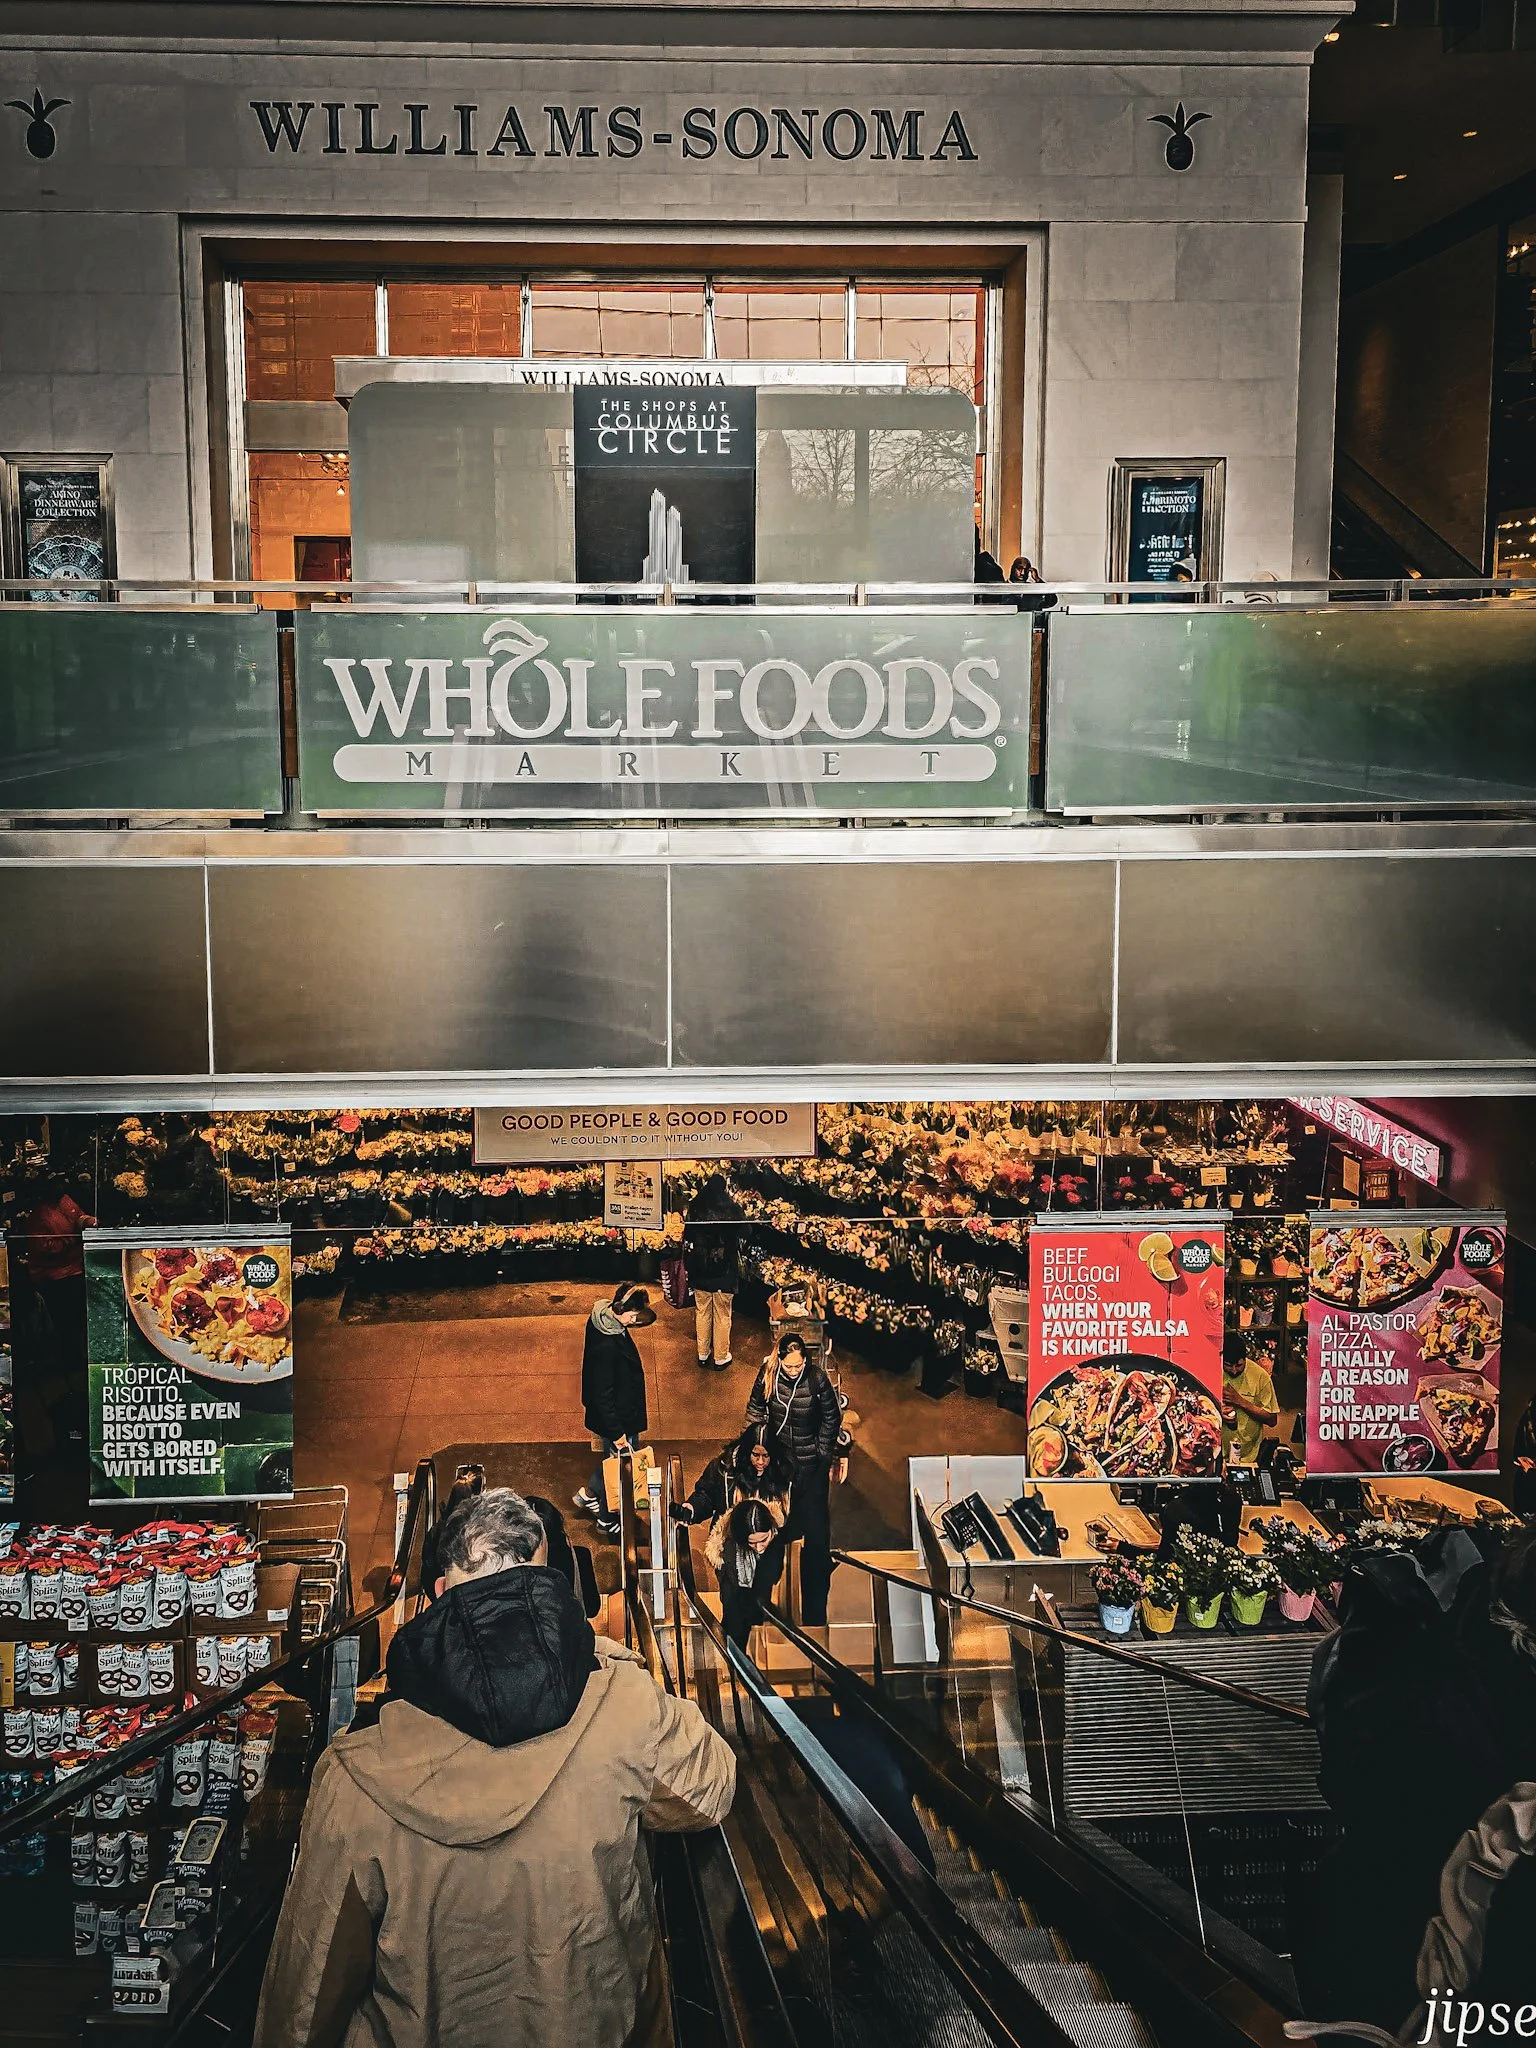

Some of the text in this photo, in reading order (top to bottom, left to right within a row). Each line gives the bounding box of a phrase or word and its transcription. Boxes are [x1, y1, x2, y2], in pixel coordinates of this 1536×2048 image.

[250, 100, 979, 161] WILLIAMS-SONOMA
[520, 371, 726, 386] WILLIAMS-SONOMA
[601, 400, 726, 412] THE SHOPS AT
[597, 413, 731, 430] COLUMBUS
[597, 430, 731, 454] CIRCLE
[34, 499, 98, 508] DINNERWARE
[35, 508, 97, 518] COLLECTION
[323, 620, 1002, 740] WHOLE FOODS
[406, 750, 942, 777] MARKET
[501, 1109, 789, 1131] GOOD PEOPLE & GOOD FOOD
[550, 1132, 744, 1146] WE COULDN'T DO IT WITHOUT YOU!
[1319, 1096, 1431, 1180] SERVICE
[1181, 1245, 1210, 1256] WHOLE
[1462, 1240, 1492, 1251] WHOLE
[1463, 1250, 1491, 1258] FOODS
[1043, 1247, 1088, 1264] BEEF
[246, 1260, 276, 1271] WHOLE
[1042, 1266, 1120, 1283] BULGOGI
[1042, 1284, 1101, 1301] TACOS.
[1041, 1302, 1151, 1320] WHEN YOUR
[1041, 1320, 1189, 1338] FAVORITE SALSA
[1321, 1313, 1417, 1331] AL PASTOR
[1041, 1338, 1133, 1356] IS KIMCHI.
[1321, 1332, 1377, 1349] PIZZA.
[1320, 1351, 1395, 1368] FINALLY
[101, 1366, 192, 1384] TROPICAL
[1319, 1369, 1409, 1386] A REASON
[102, 1385, 183, 1403] RISOTTO.
[1320, 1387, 1355, 1404] FOR
[102, 1402, 241, 1421] BECAUSE EVEN
[1319, 1405, 1420, 1422] PINEAPPLE
[102, 1423, 182, 1440] RISOTTO
[1319, 1423, 1407, 1440] ON PIZZA.
[102, 1440, 217, 1459] GETS BORED
[103, 1458, 225, 1477] WITH ITSELF.
[158, 1584, 182, 1595] Splits
[226, 1575, 251, 1588] Splits
[33, 1585, 58, 1598] Splits
[191, 1590, 216, 1601] Splits
[91, 1601, 116, 1613] Splits
[29, 1658, 53, 1669] Splits
[122, 1660, 141, 1669] plits
[220, 1652, 242, 1662] plits
[64, 1719, 80, 1729] Spli
[177, 1753, 200, 1766] Splits
[242, 1751, 260, 1762] plits
